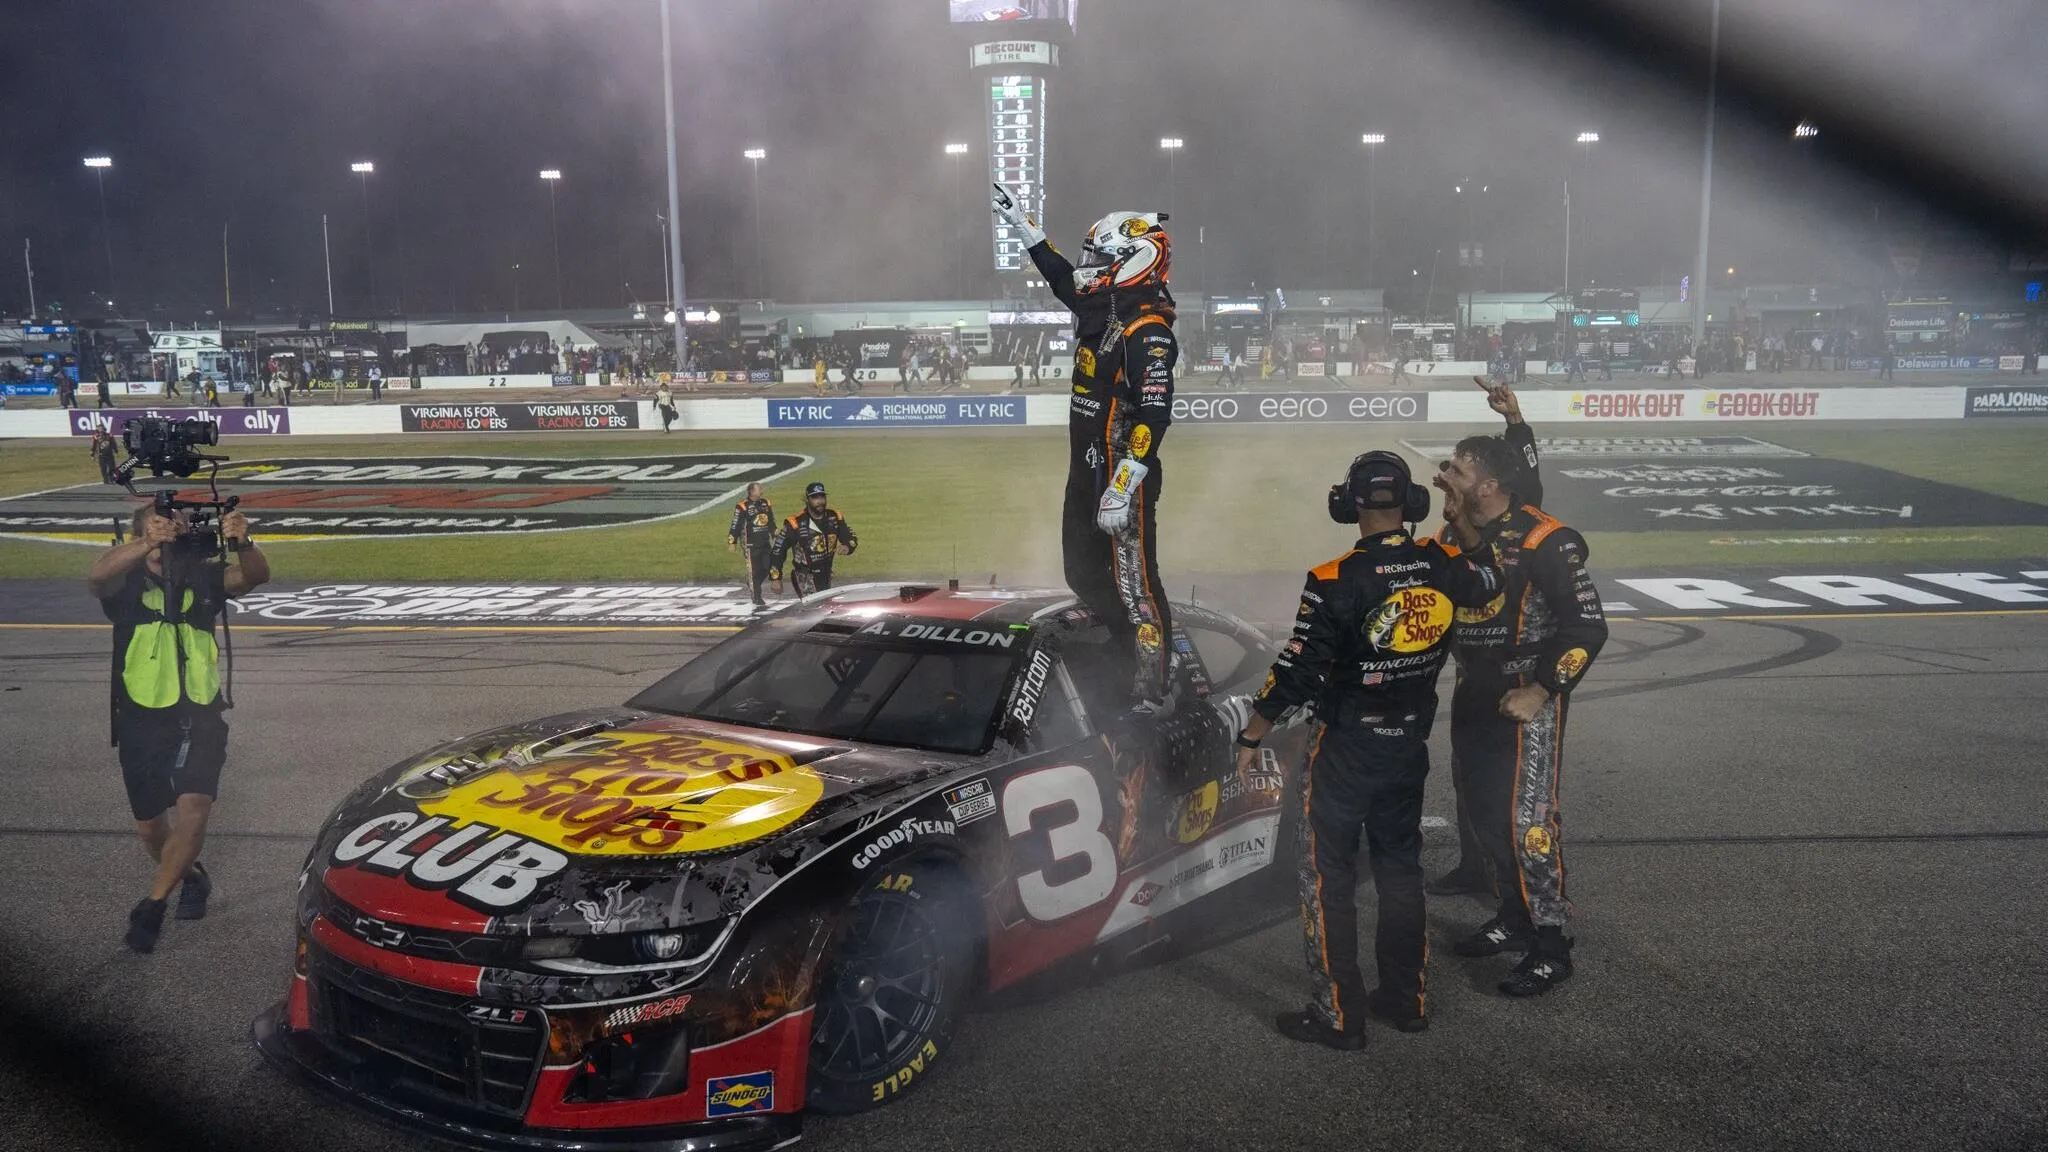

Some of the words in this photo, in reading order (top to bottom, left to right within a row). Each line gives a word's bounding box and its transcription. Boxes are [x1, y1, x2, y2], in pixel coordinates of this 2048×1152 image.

[984, 43, 1036, 54] DISCOUNT
[997, 101, 1003, 111] 1
[1017, 99, 1024, 110] 3
[997, 114, 1003, 125] 2
[997, 129, 1004, 139] 3
[1015, 128, 1027, 139] 12
[998, 144, 1004, 153] 4
[1016, 143, 1027, 153] 22
[1019, 157, 1026, 167] 2
[1019, 171, 1026, 181] 5
[997, 229, 1008, 238] 10
[999, 243, 1008, 253] 11
[999, 257, 1009, 267] 12
[337, 322, 368, 330] Robinhood
[1890, 318, 1928, 327] Delaware
[1930, 318, 1946, 326] Life
[1897, 360, 1948, 369] Delaware
[1950, 359, 1971, 368] Life
[554, 374, 573, 382] eero
[1260, 397, 1327, 418] eero
[1349, 397, 1417, 417] eero
[1584, 393, 1640, 417] COOK
[1644, 393, 1685, 417] OUT
[1717, 392, 1775, 417] COOK
[1778, 392, 1820, 416] OUT
[1974, 393, 2006, 407] PAPA
[411, 407, 462, 418] VIRGINIA
[463, 406, 473, 417] IS
[475, 406, 499, 417] FOR
[528, 405, 579, 416] VIRGINIA
[582, 405, 592, 416] IS
[593, 404, 618, 416] FOR
[779, 406, 805, 420] FLY
[808, 406, 833, 420] RIC
[883, 404, 946, 415] RICHMOND
[959, 404, 986, 418] FLY
[988, 403, 1014, 417] RIC
[1171, 398, 1238, 420] eero
[78, 411, 113, 434] ally
[244, 410, 281, 433] ally
[421, 418, 465, 429] RACING
[538, 417, 583, 428] RACING
[243, 465, 538, 481] COOK
[542, 463, 777, 480] OUT
[261, 516, 556, 528] RACEWAY
[1383, 560, 1431, 574] RCRracing
[344, 587, 561, 597] WHO'S
[566, 587, 744, 597] YOUR
[1402, 591, 1437, 610] Bass
[1403, 609, 1430, 626] Pro
[863, 621, 889, 636] A.
[900, 623, 1016, 648] DILLON
[1403, 624, 1444, 644] Shops
[1359, 649, 1443, 671] WINCHESTER
[612, 735, 783, 785] Bass
[1522, 721, 1541, 826] WINCHESTER
[958, 782, 984, 800] NASCAR
[479, 777, 708, 851] Shops
[958, 805, 971, 817] CUP
[970, 797, 990, 814] SERIES
[852, 817, 956, 870] GOODYEAR
[1003, 765, 1118, 921] 3
[1229, 836, 1265, 856] TITAN
[334, 811, 568, 907] CLUB
[636, 994, 692, 1021] RCR
[872, 1039, 938, 1102] EAGLE
[709, 1085, 770, 1105] SUNOCO
